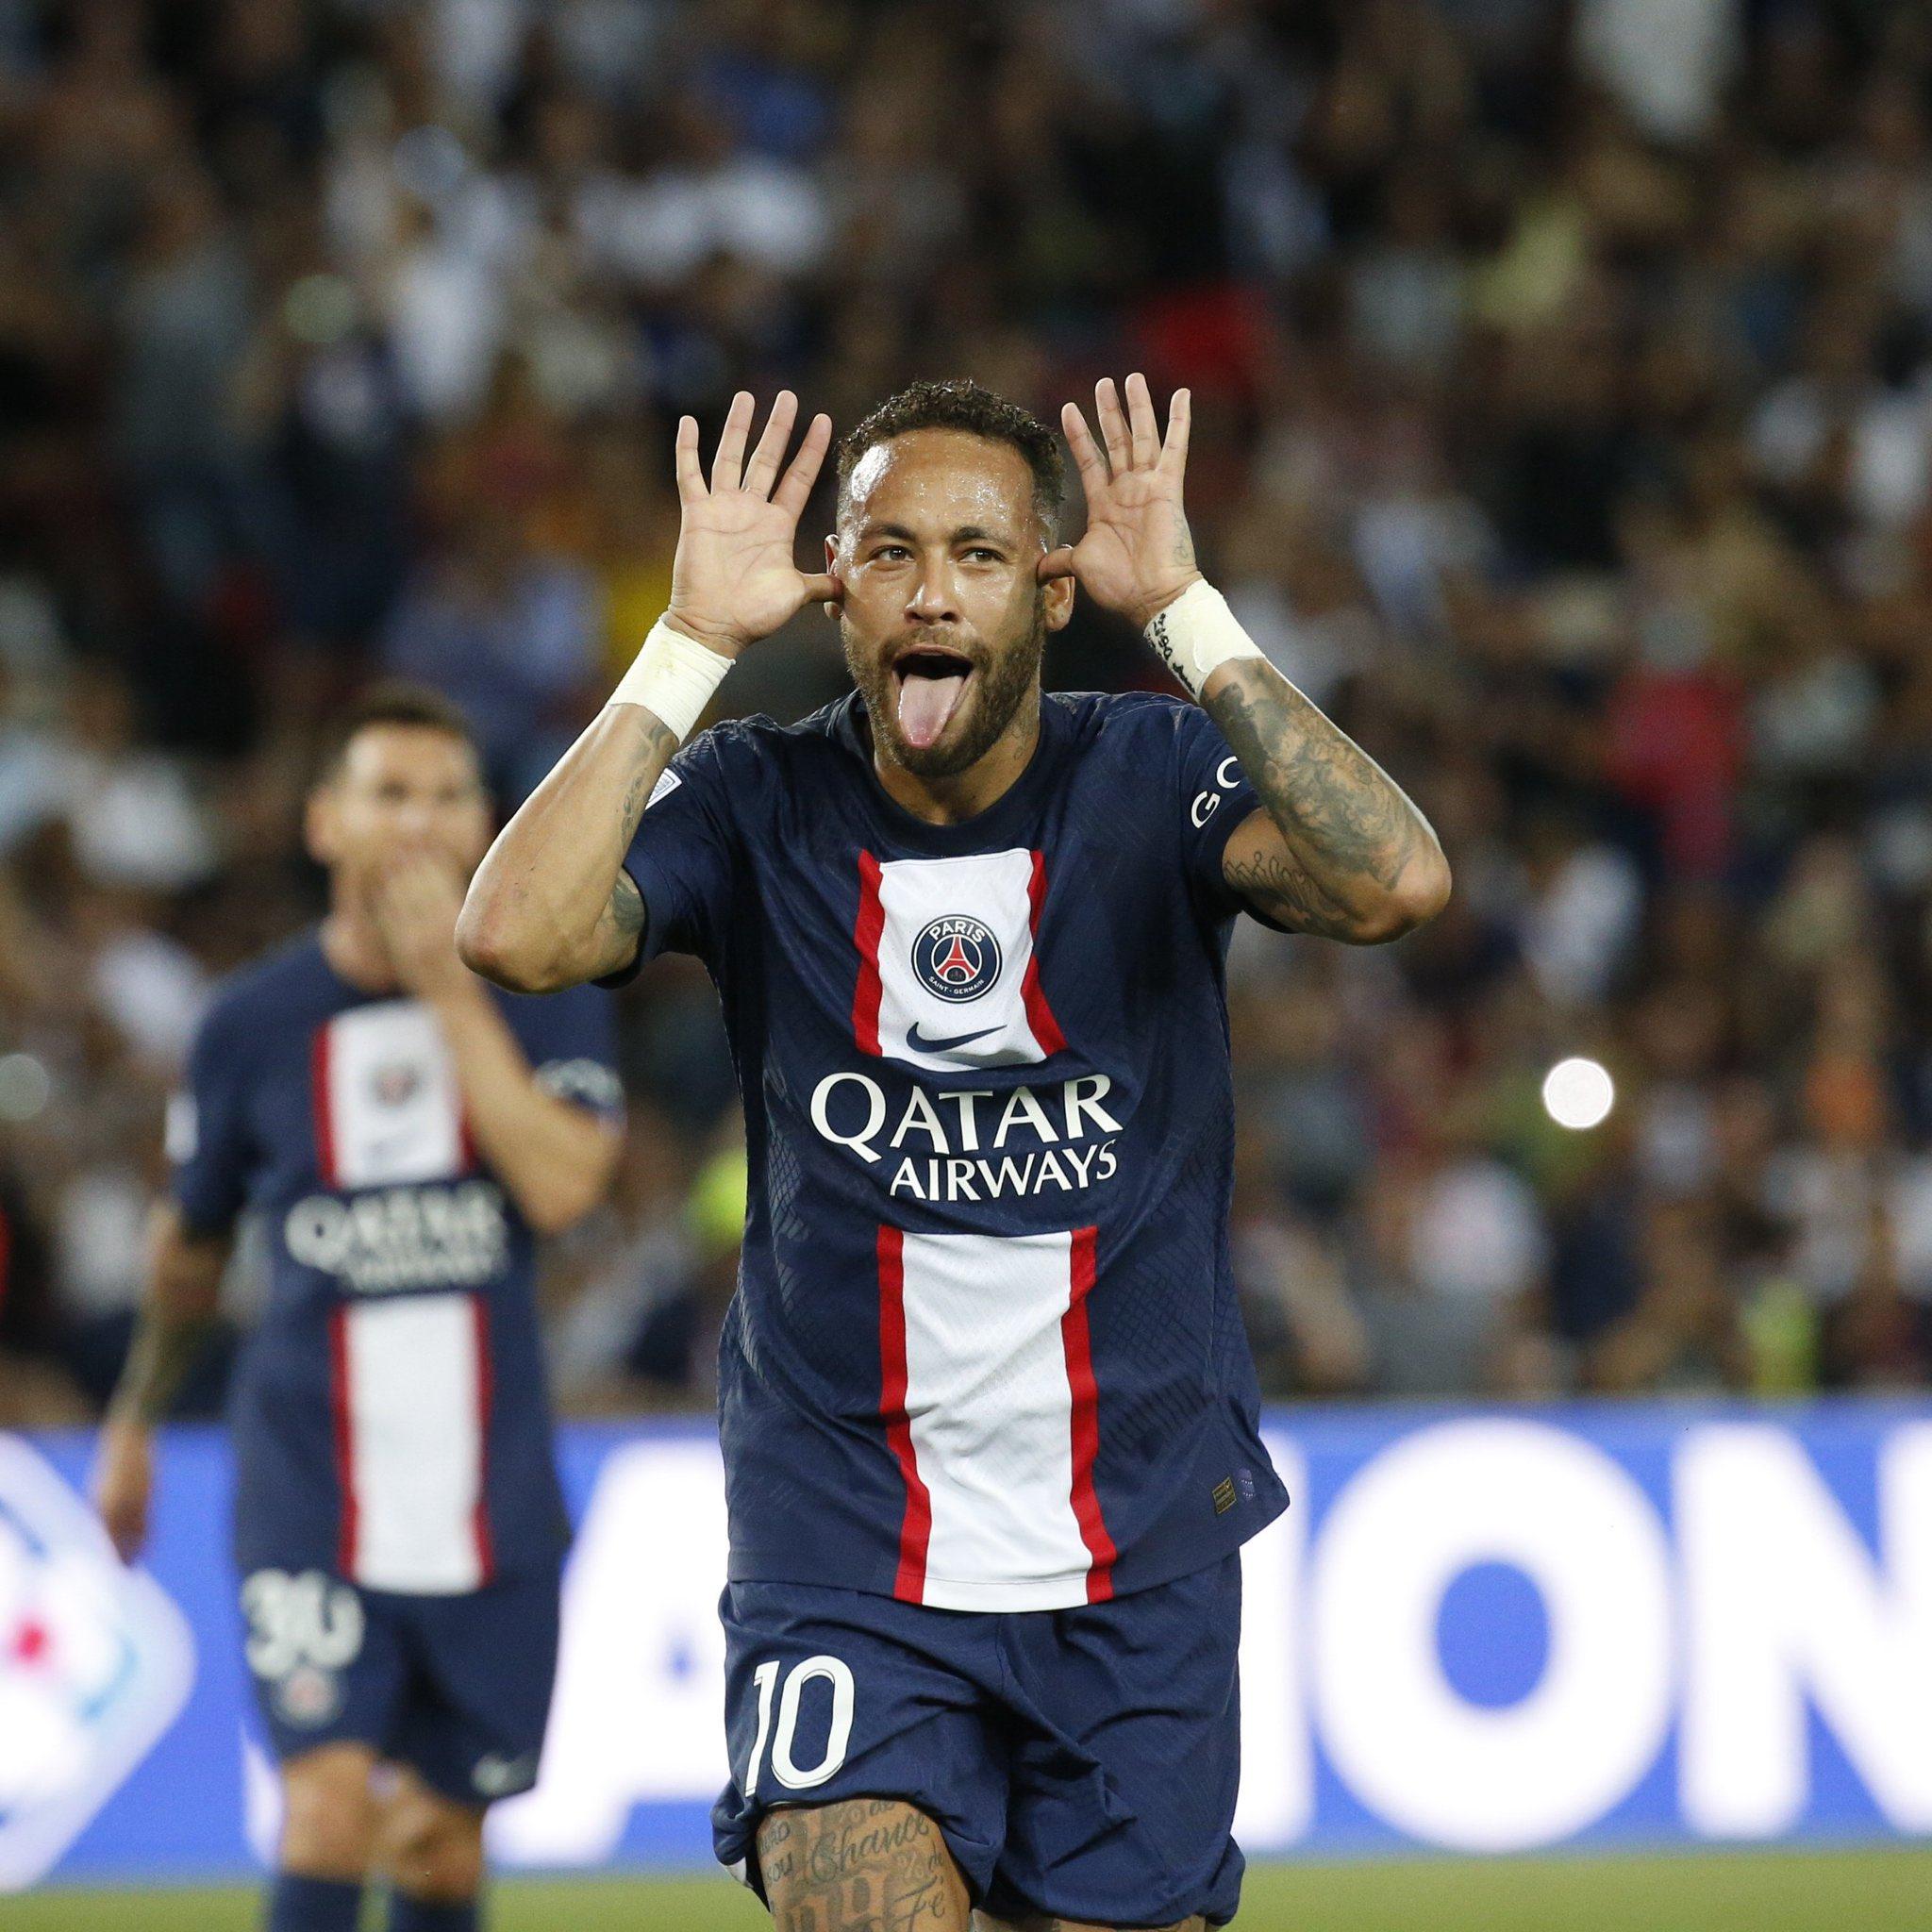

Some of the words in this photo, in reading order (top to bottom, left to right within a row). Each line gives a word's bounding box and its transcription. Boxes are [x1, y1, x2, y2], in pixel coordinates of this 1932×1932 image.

[928, 920, 986, 943] PARIS
[809, 1072, 1124, 1164] QATAR
[890, 1138, 1118, 1202] AIRWAYS
[744, 1654, 855, 1798] 10
